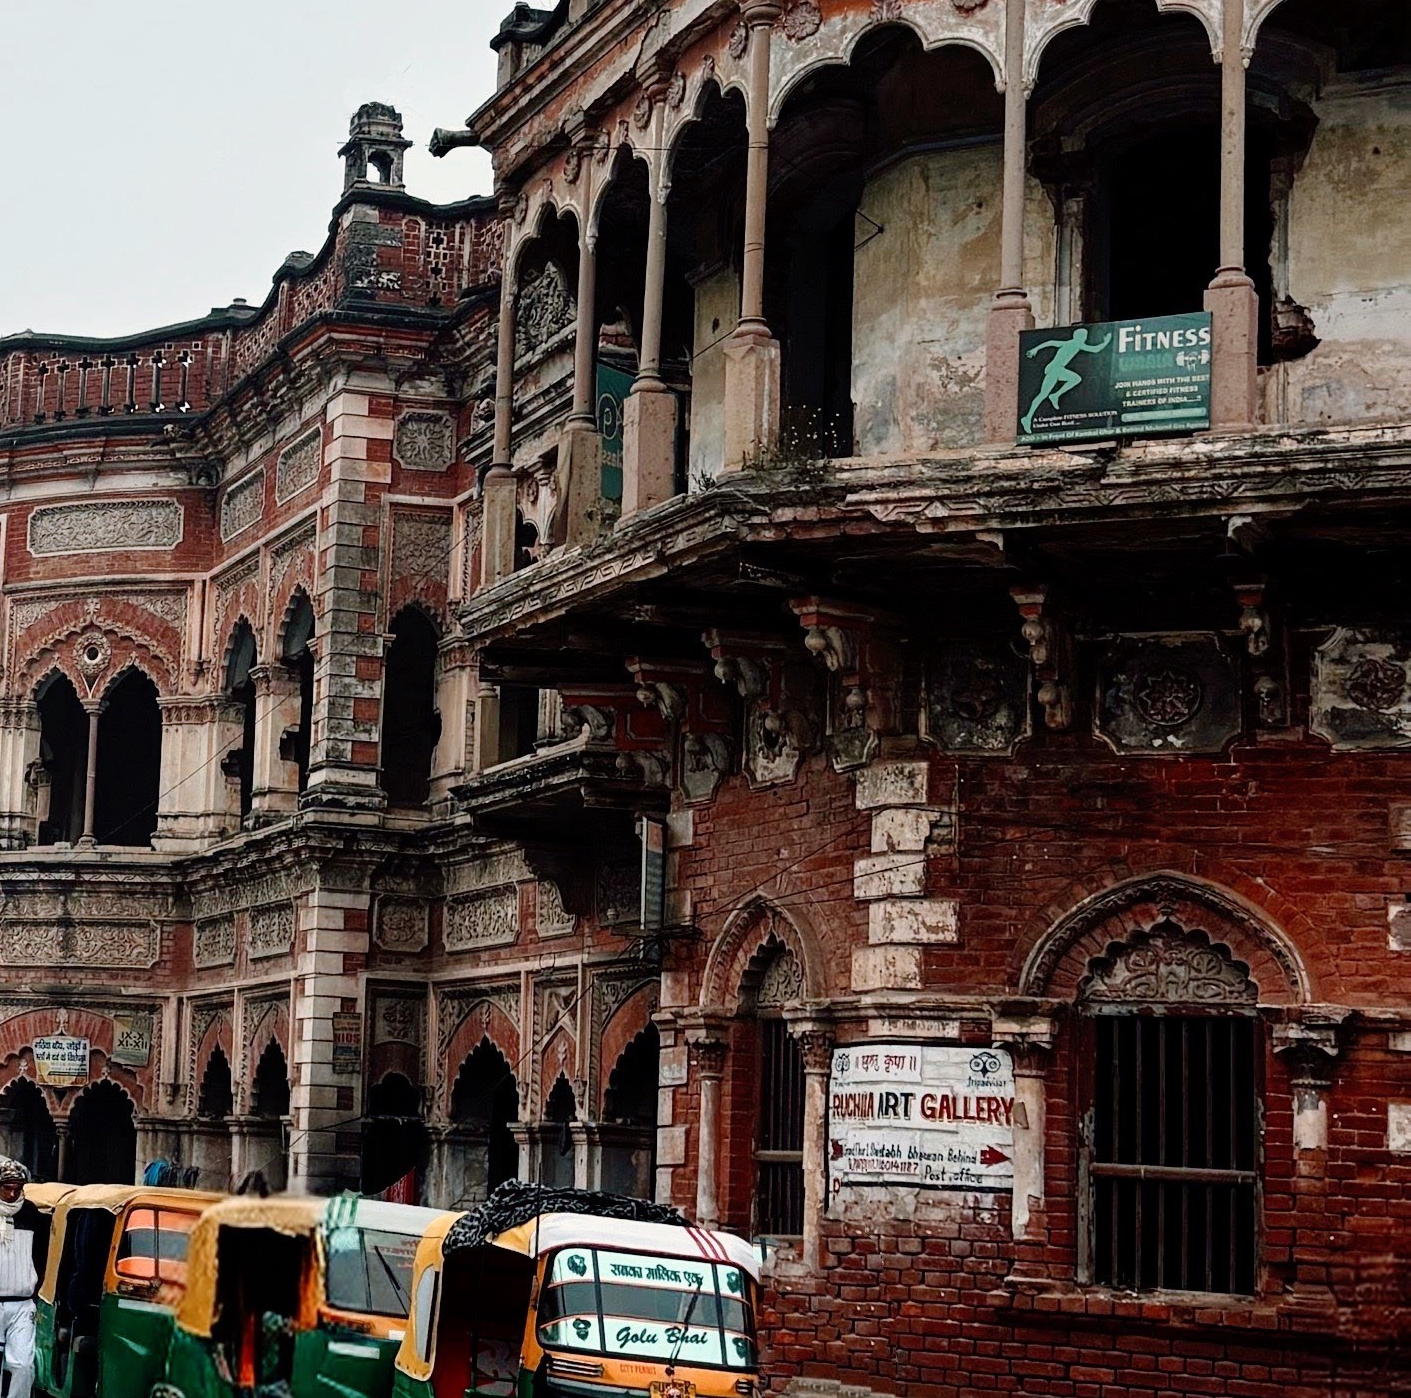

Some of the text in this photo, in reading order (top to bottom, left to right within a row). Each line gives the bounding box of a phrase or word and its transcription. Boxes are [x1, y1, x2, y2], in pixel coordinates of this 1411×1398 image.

[1115, 381, 1132, 389] JOIN
[1132, 379, 1156, 387] HANDS
[1191, 374, 1210, 383] BEST
[1132, 388, 1168, 397] CERTIFIED
[1169, 385, 1198, 394] FITNESS
[118, 1039, 147, 1049] XI-XII
[920, 1093, 1014, 1126] GALLERY
[924, 1165, 946, 1182] Post
[616, 1326, 708, 1349] Golu Bhai
